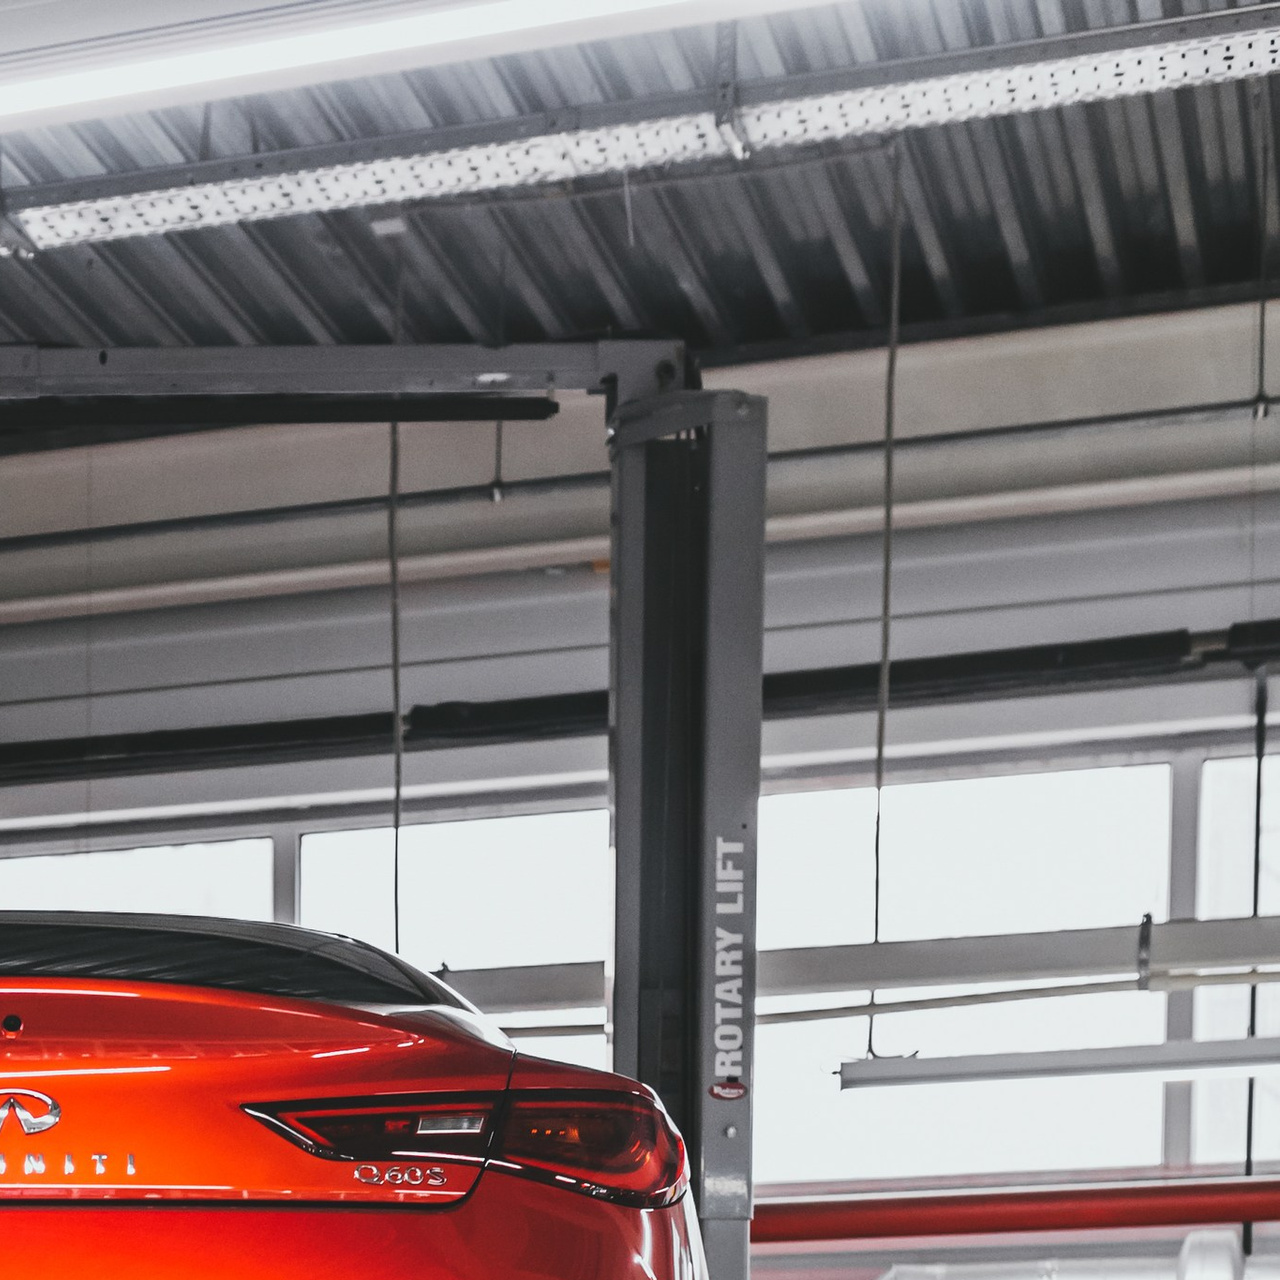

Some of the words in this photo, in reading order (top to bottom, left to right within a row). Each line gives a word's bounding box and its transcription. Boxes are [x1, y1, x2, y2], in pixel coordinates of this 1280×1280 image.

[715, 836, 744, 914] LIFT
[714, 926, 744, 1077] ROTARY
[353, 1164, 447, 1186] Q60S
